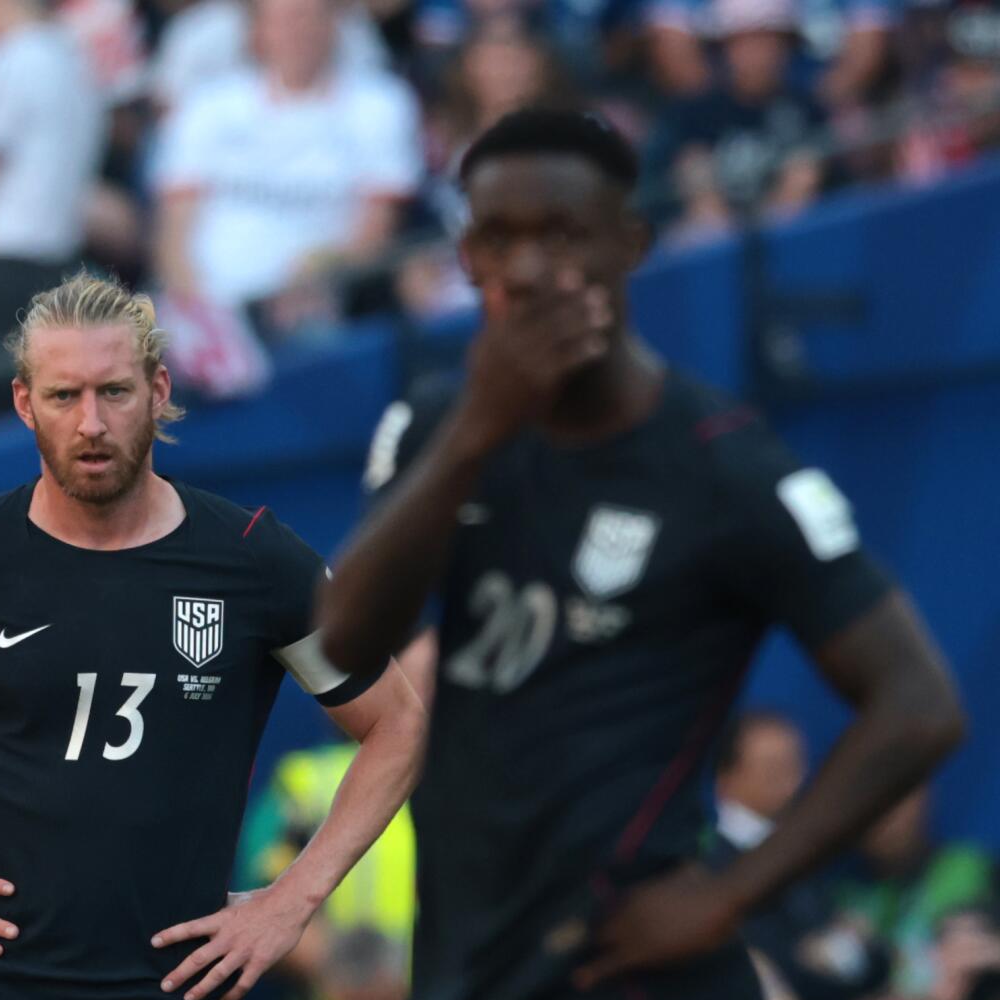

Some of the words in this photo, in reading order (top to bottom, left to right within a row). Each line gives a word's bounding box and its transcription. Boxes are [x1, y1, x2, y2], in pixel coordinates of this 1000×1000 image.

[178, 601, 220, 628] USA
[449, 572, 556, 693] 20
[65, 672, 156, 760] 13
